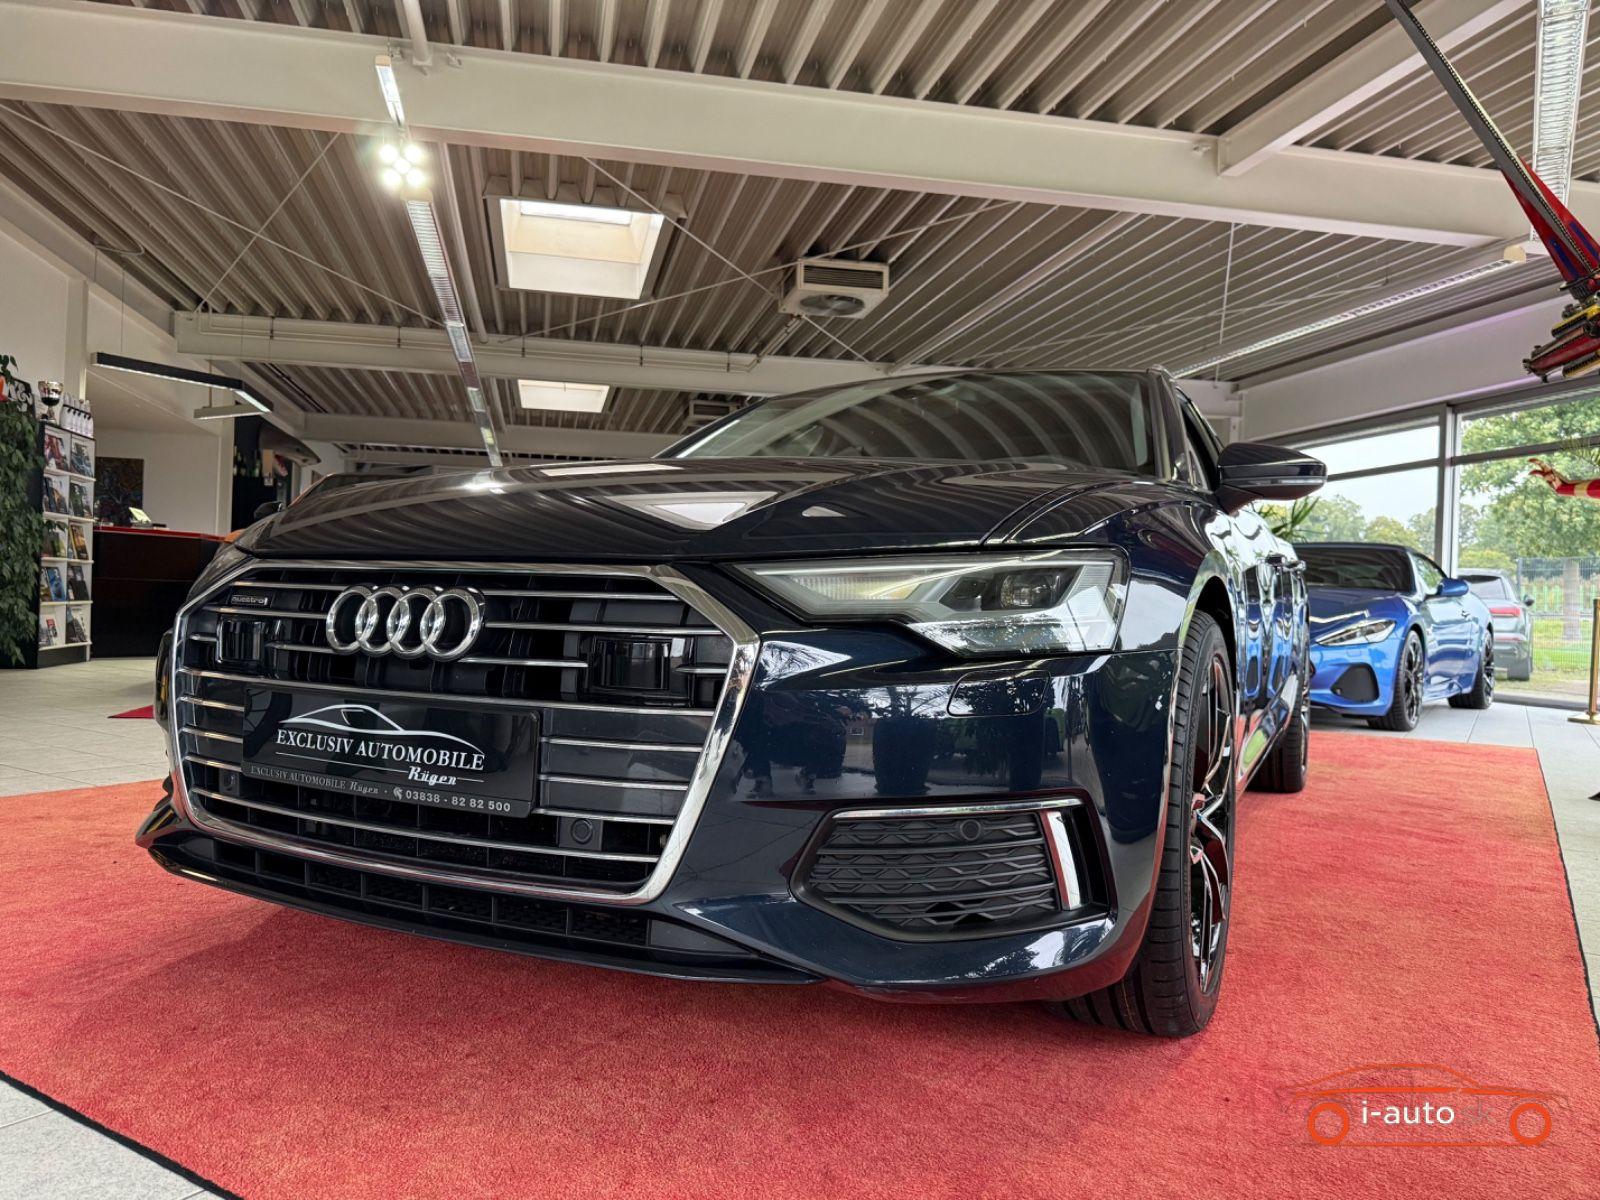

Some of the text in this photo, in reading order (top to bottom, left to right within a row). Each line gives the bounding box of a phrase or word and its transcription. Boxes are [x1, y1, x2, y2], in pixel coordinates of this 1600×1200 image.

[276, 729, 485, 770] EXCLUSIV AUTOMOBILE
[251, 765, 288, 779] EXCLUSIV
[289, 773, 346, 790] AUTOMOBILE
[405, 790, 440, 803] 03838
[451, 796, 466, 807] 82
[469, 798, 484, 809] 82
[488, 801, 511, 812] 500
[408, 765, 457, 785] Rügen
